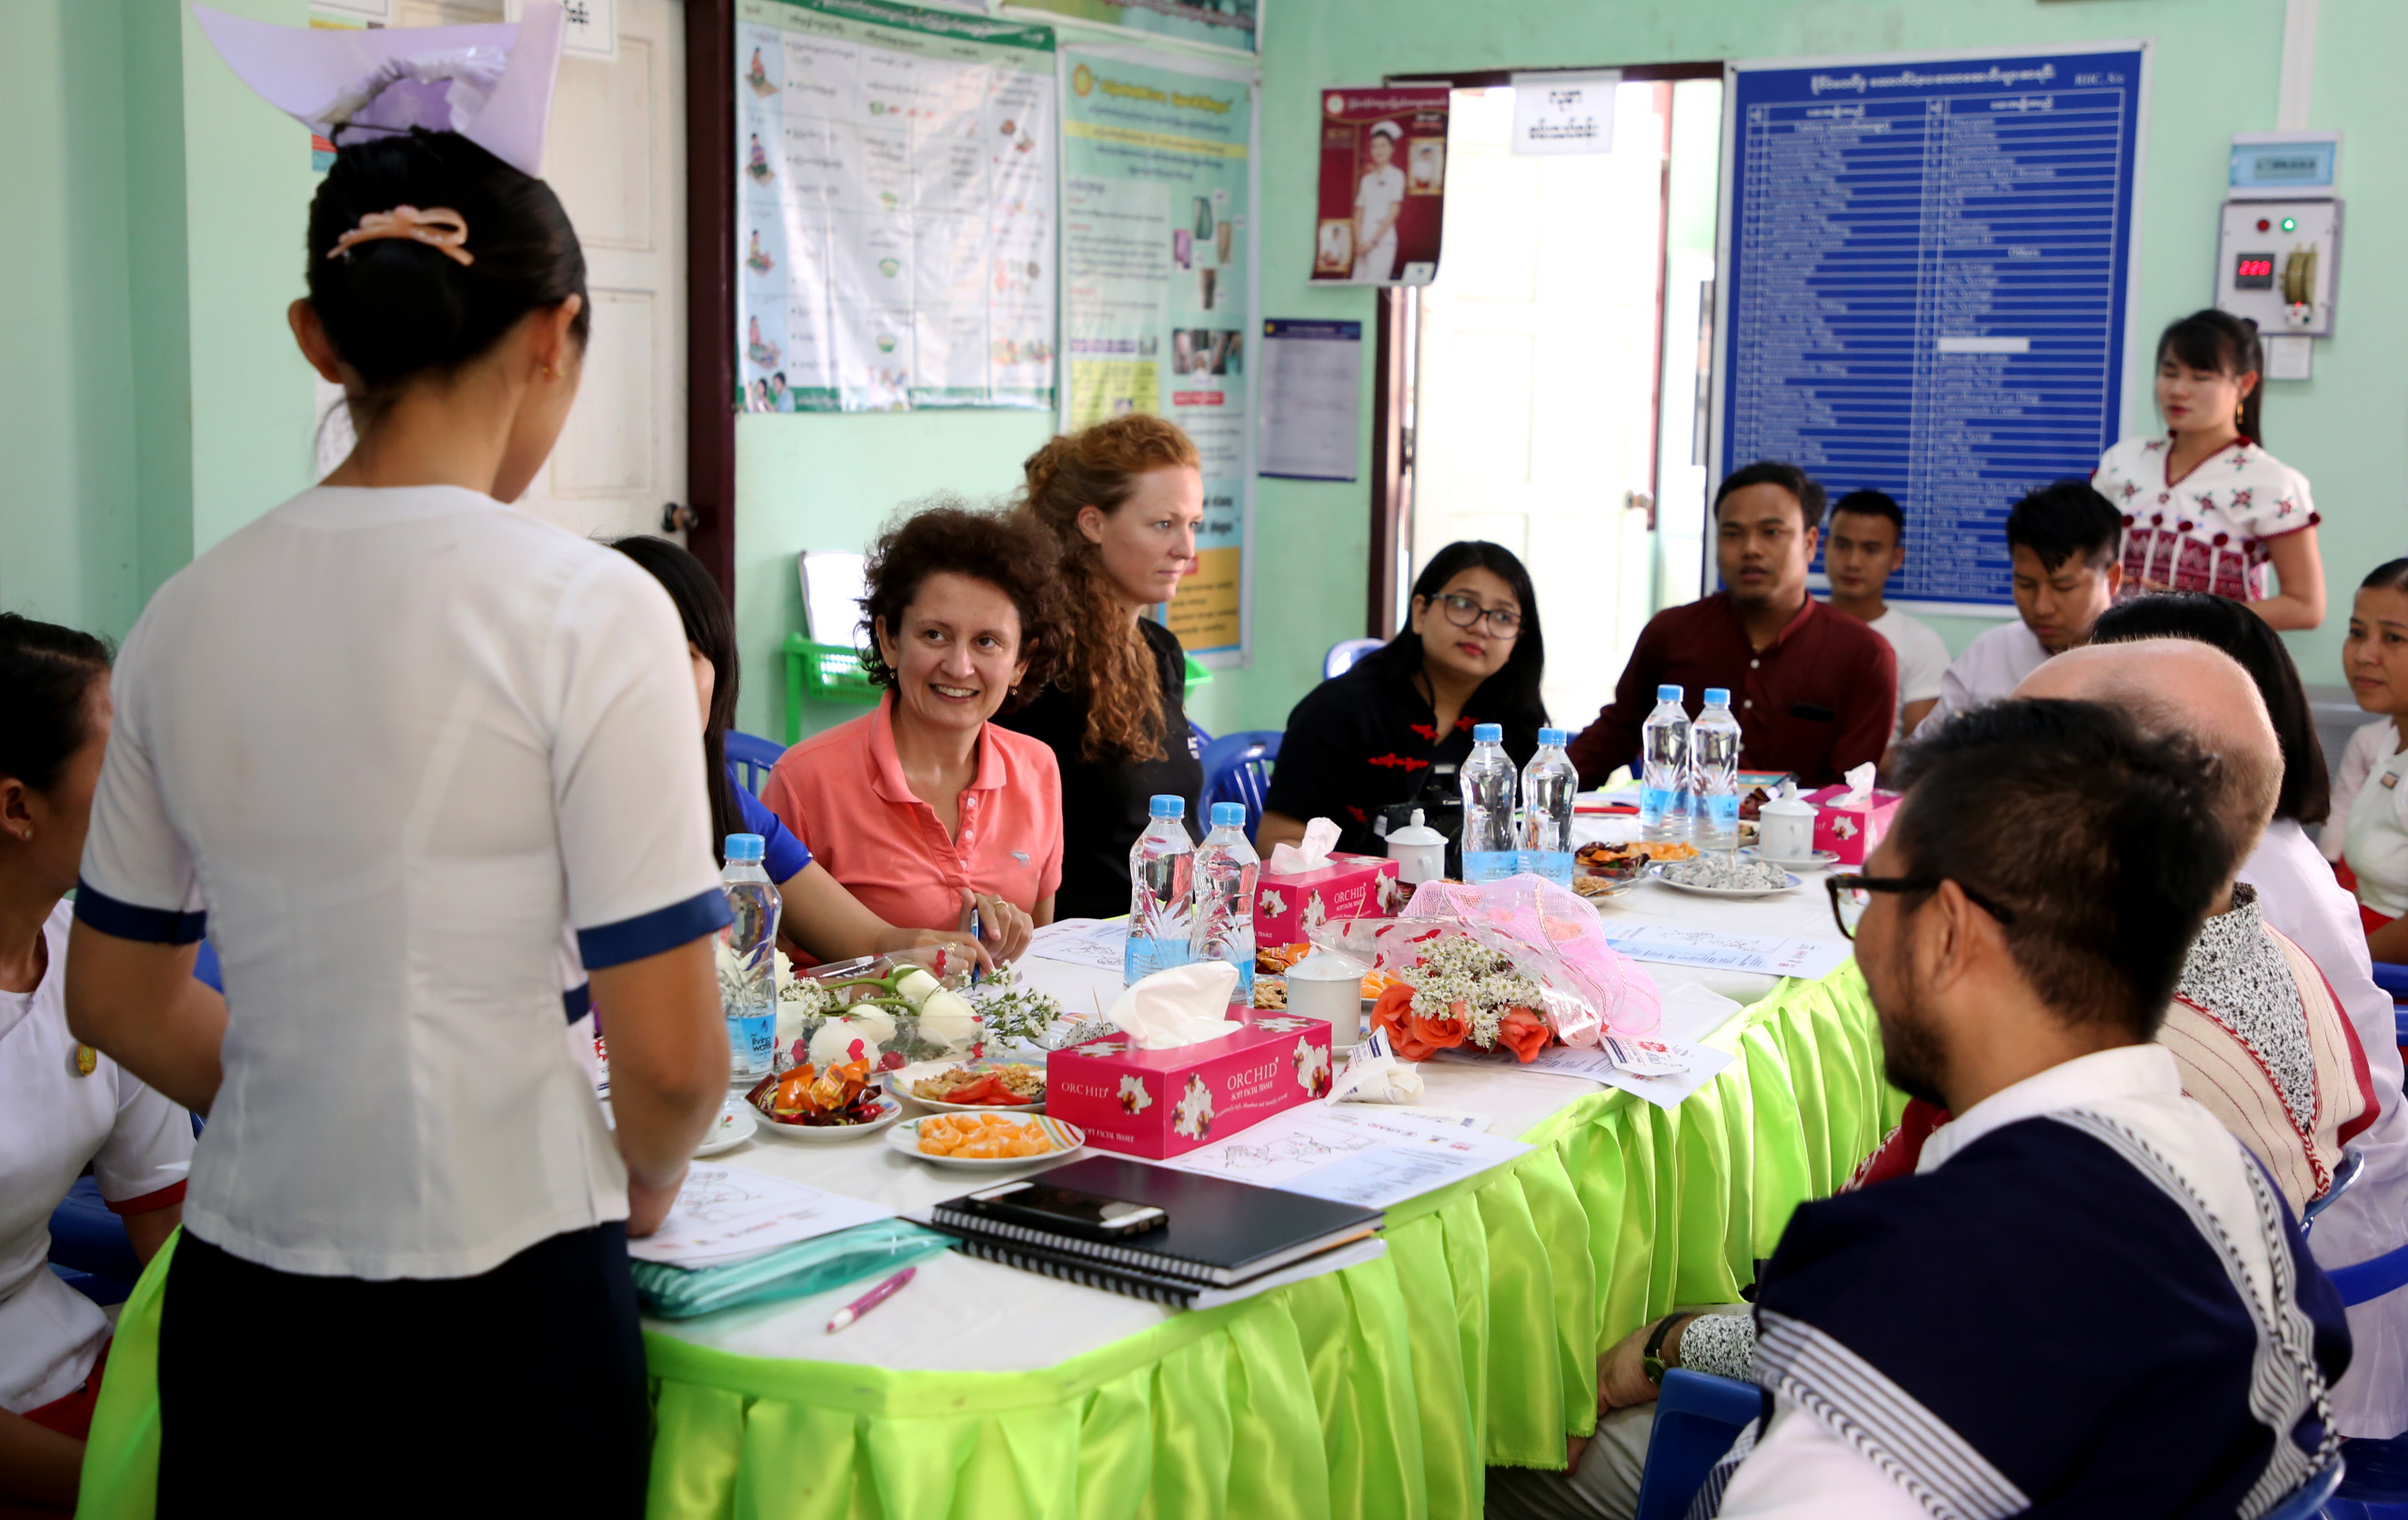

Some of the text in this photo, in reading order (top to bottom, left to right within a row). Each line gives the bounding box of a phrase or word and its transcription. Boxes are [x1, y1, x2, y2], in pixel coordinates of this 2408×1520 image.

[1334, 885, 1366, 904] ORCHID
[752, 1035, 771, 1045] living
[752, 1043, 772, 1052] water
[1228, 1062, 1278, 1090] ORCHID
[1061, 1081, 1108, 1098] ORCHID
